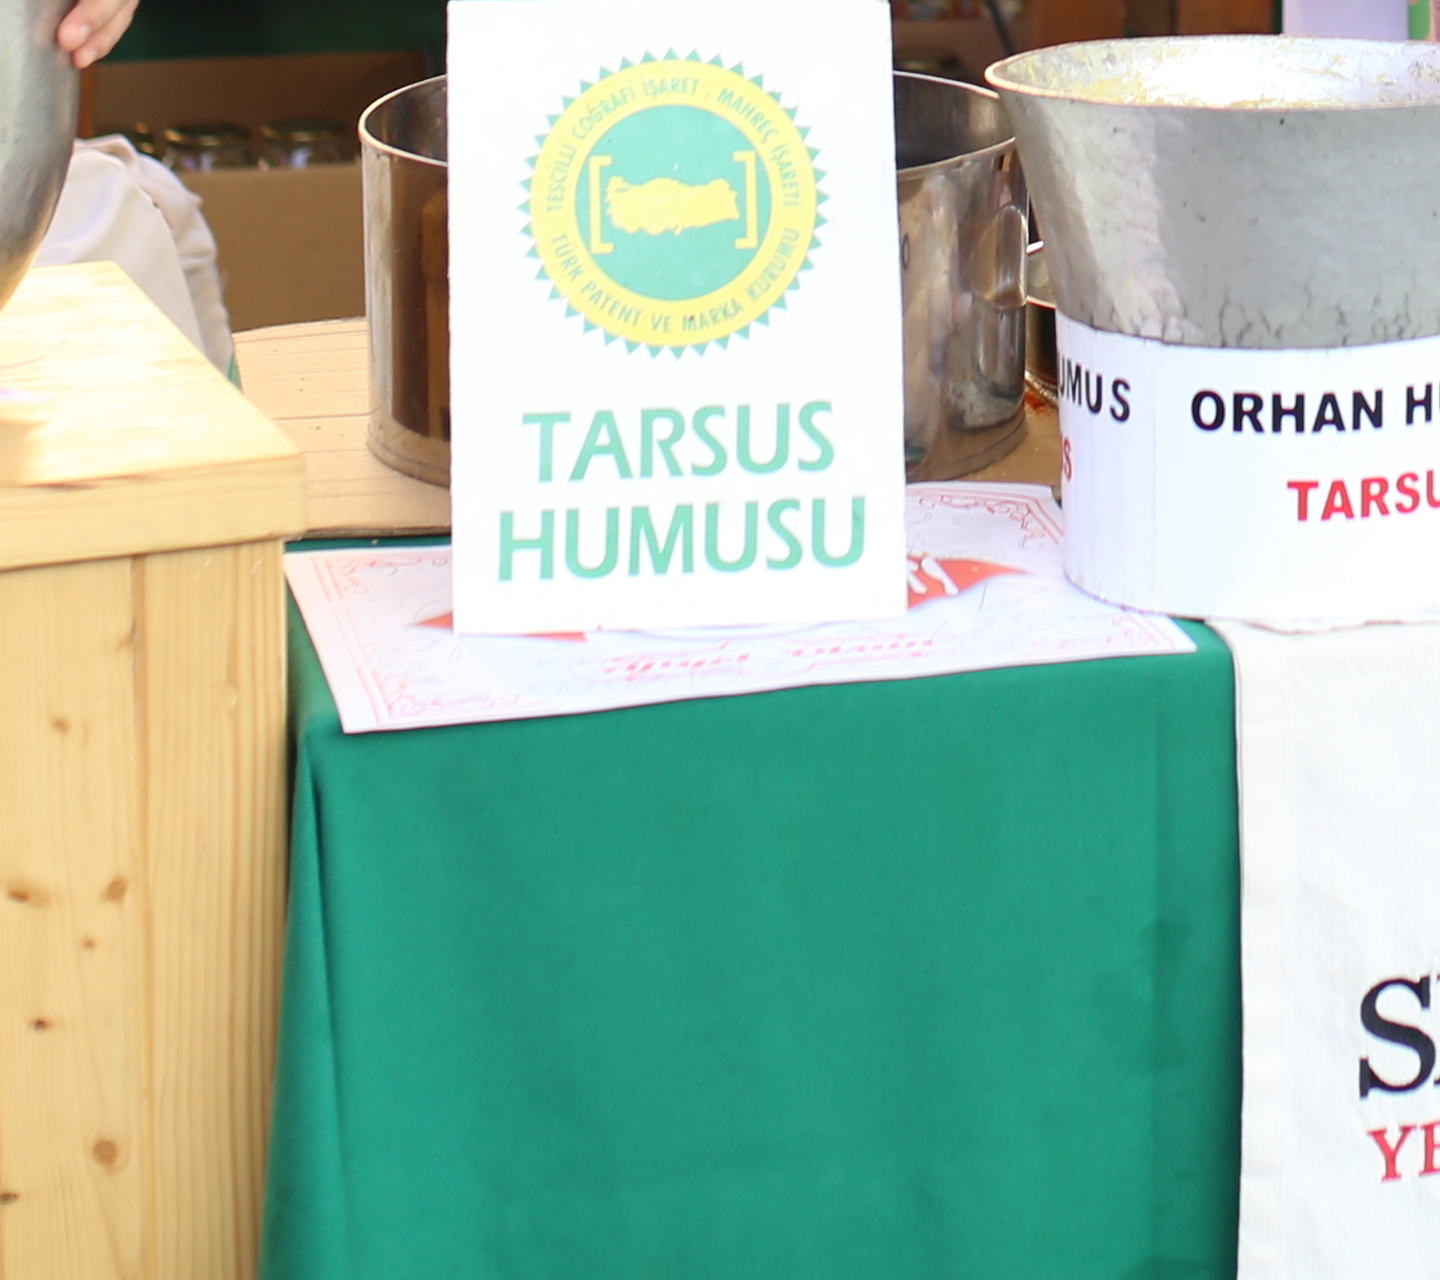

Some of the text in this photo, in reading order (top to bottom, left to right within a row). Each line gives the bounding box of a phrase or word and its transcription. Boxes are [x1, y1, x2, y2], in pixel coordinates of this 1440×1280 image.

[550, 233, 586, 282] TÜRK
[580, 280, 643, 327] PATENT
[651, 313, 672, 333] VE
[682, 297, 744, 332] MARKA
[522, 401, 835, 483] TARSUS
[1191, 389, 1383, 434] ORHAN
[498, 495, 866, 582] HUMUSU
